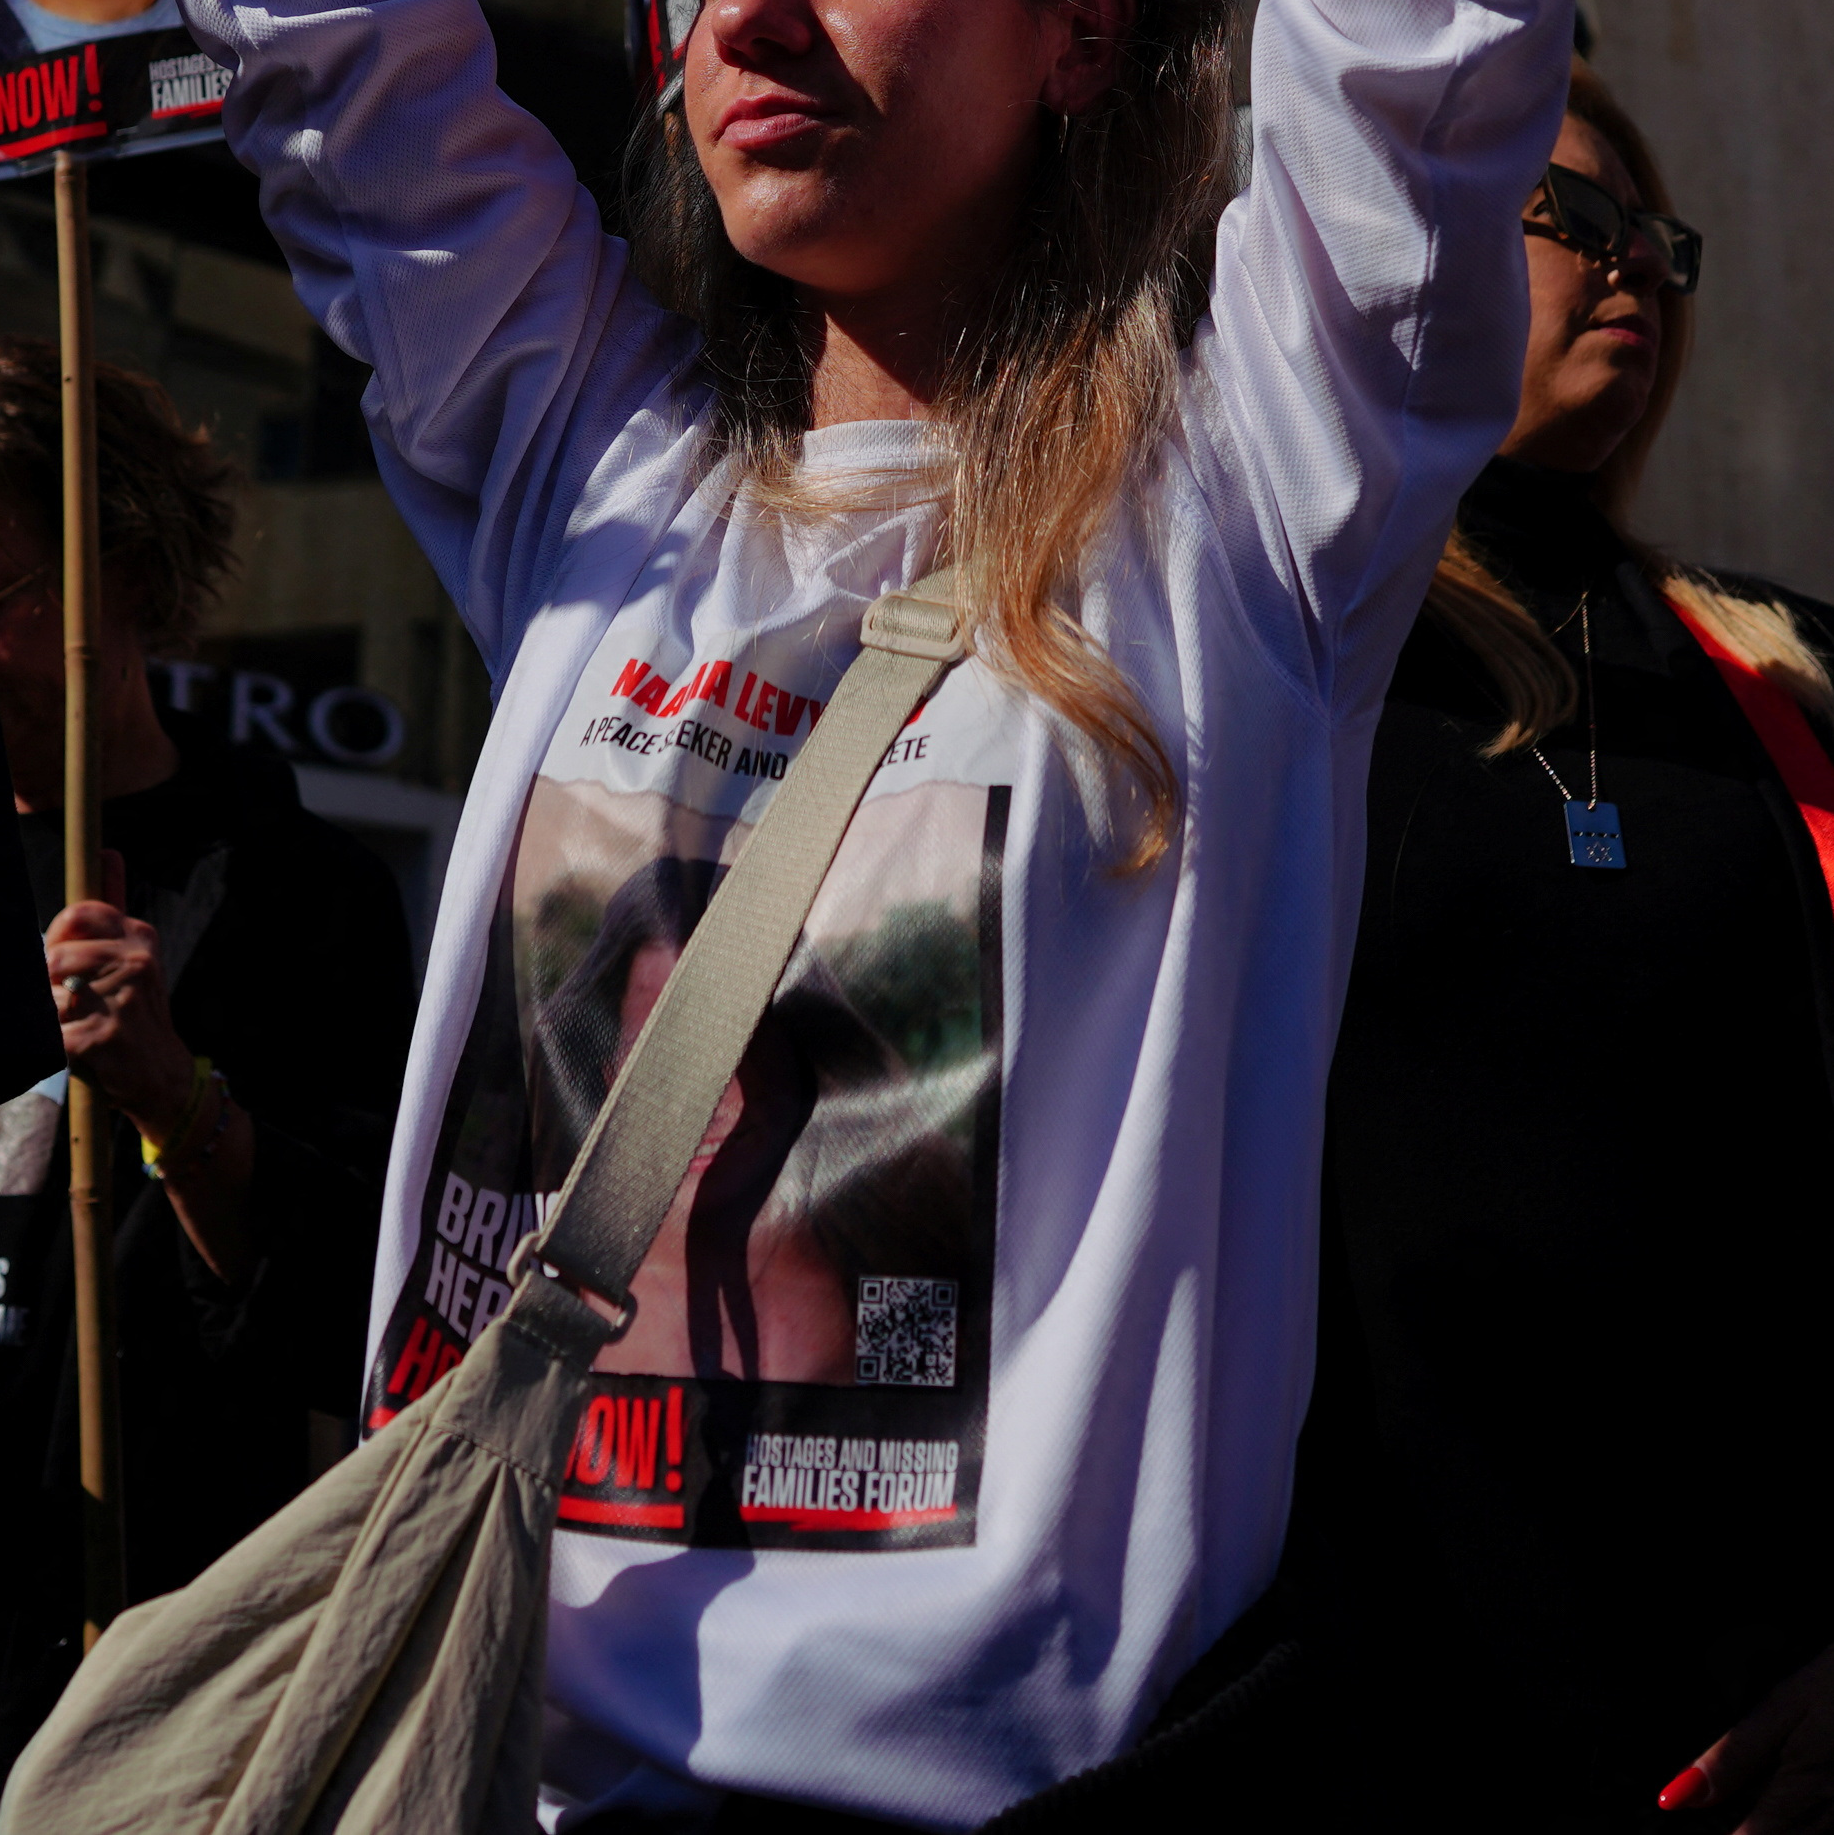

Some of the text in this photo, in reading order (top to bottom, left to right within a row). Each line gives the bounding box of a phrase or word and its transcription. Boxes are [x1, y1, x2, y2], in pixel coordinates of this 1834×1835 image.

[150, 68, 234, 114] FAMILIES
[580, 719, 594, 748] A
[591, 716, 661, 756] PEACE
[734, 747, 790, 782] AND
[745, 1432, 960, 1473] HOSTAGES AND MISSING
[741, 1465, 957, 1514] FAMILIES FORUM
